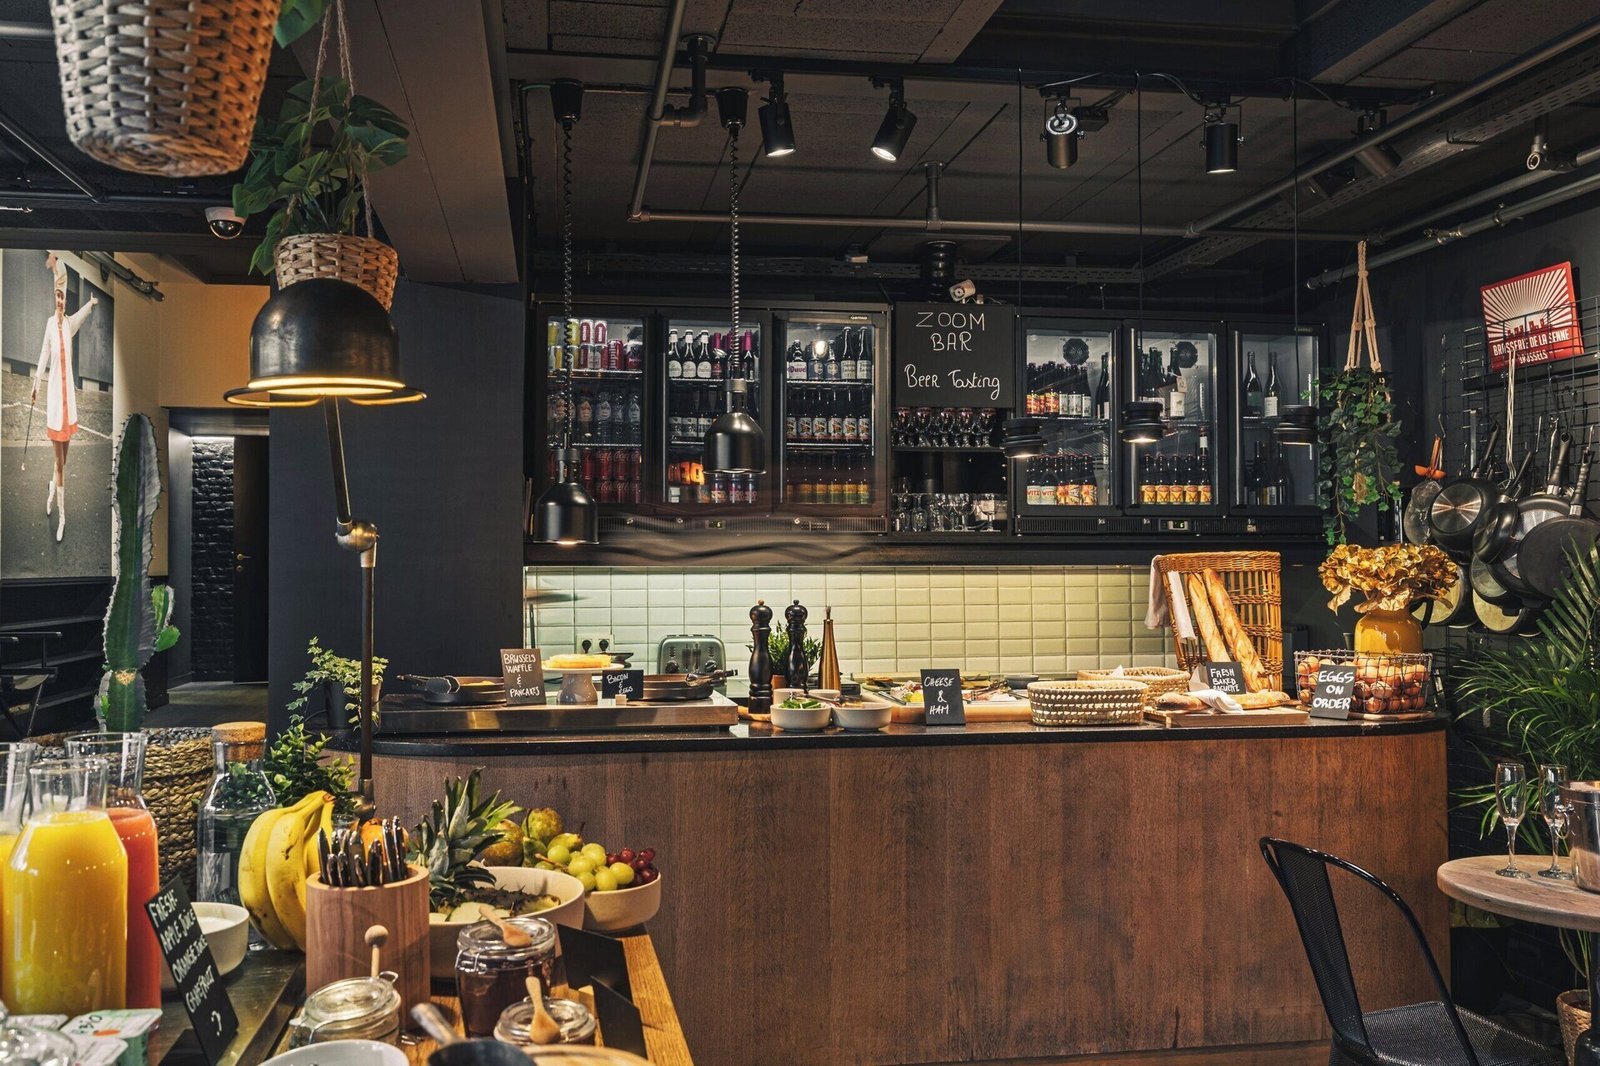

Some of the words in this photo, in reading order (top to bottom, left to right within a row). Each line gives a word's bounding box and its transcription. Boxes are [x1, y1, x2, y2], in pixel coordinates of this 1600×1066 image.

[915, 311, 985, 331] ZOOM
[930, 331, 972, 351] BAR
[1529, 336, 1538, 348] DE
[1538, 334, 1548, 346] LA
[947, 369, 1000, 400] Tasting
[505, 663, 533, 673] WAFFLE
[1210, 668, 1235, 678] FRESH
[923, 676, 955, 687] CHEESE
[1212, 677, 1237, 686] BAKED
[1318, 670, 1355, 684] EGGS
[1325, 684, 1345, 695] ON
[937, 690, 947, 703] &
[929, 704, 949, 715] HAM
[1312, 697, 1351, 710] ORDER
